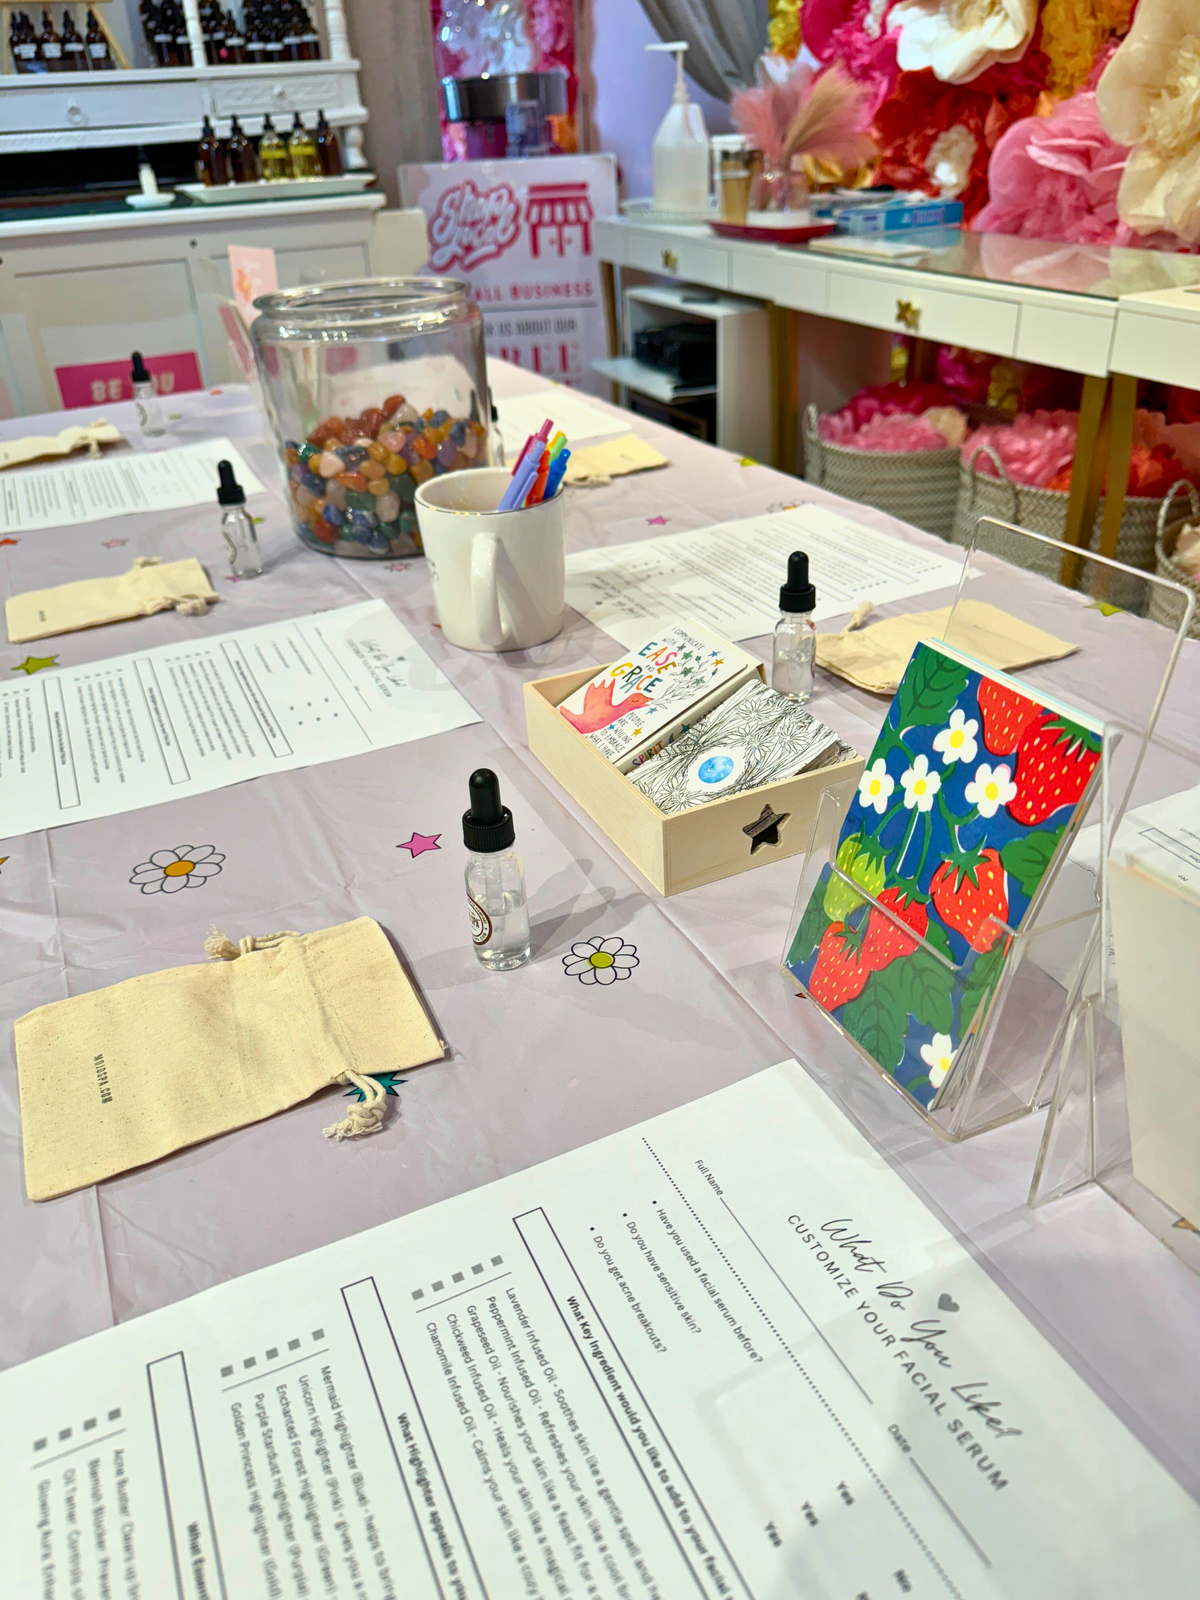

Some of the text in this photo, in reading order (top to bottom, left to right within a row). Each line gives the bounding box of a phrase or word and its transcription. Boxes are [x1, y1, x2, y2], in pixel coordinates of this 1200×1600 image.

[508, 281, 593, 301] BUSINESS
[487, 342, 583, 374] REE
[91, 378, 123, 403] BE
[637, 641, 678, 675] EASE
[661, 636, 678, 647] WITH
[673, 628, 705, 651] COMMUNICATE
[610, 662, 664, 694] GRACE
[613, 726, 633, 745] WILLING
[617, 717, 629, 728] ARE
[624, 711, 646, 728] PEOPLE
[589, 732, 602, 746] WHAT
[600, 746, 616, 760] HAVE
[599, 727, 627, 754] TO EMBRACE
[631, 740, 664, 767] SPIRIT
[694, 1159, 724, 1196] Full Name
[592, 1235, 668, 1353] Do you get acne breakouts?
[626, 1221, 702, 1334] Do you have sensitive skin?
[656, 1208, 764, 1363] Have you used a facial serum before?
[820, 1218, 887, 1274] What
[875, 1280, 914, 1311] Do
[899, 1319, 952, 1369] You
[787, 1214, 1010, 1492] CUSTOMIZE YOUR FACIAL SERUM
[446, 1313, 475, 1365] Chickweed
[466, 1363, 491, 1404] Infused
[483, 1402, 499, 1421] Oil
[492, 1425, 512, 1459] Heals
[502, 1457, 524, 1485] your
[466, 1304, 496, 1355] Grapeseed
[487, 1354, 503, 1371] Oil
[497, 1376, 526, 1430] Nourishes
[517, 1428, 538, 1455] your
[531, 1455, 548, 1481] skin
[485, 1295, 517, 1351] Peppermint
[510, 1349, 536, 1389] Infused
[527, 1388, 543, 1406] Oil
[537, 1410, 569, 1467] Refreshes
[559, 1465, 582, 1493] your
[505, 1287, 532, 1330] Lavender
[525, 1329, 551, 1367] Infused
[543, 1366, 558, 1384] Oil
[553, 1388, 580, 1433] Soothes
[573, 1432, 591, 1456] skin
[585, 1454, 601, 1477] like
[566, 1295, 585, 1322] What
[579, 1320, 595, 1340] Key
[588, 1339, 623, 1393] Ingredient
[616, 1391, 642, 1426] would
[631, 1424, 651, 1448] you
[645, 1445, 663, 1470] like
[657, 1468, 670, 1485] to
[230, 1401, 247, 1441] Golden
[253, 1392, 270, 1429] Purple
[298, 1374, 317, 1416] Unicorn
[309, 1414, 334, 1476] Highlighter
[320, 1365, 343, 1411] Mermaid
[333, 1410, 359, 1470] Highlighter
[426, 1322, 453, 1376] Chamomile
[446, 1375, 471, 1416] Infused
[462, 1415, 478, 1434] Oil
[471, 1438, 492, 1476] Calms
[482, 1474, 504, 1503] your
[275, 1383, 300, 1441] Enchanted
[289, 1439, 308, 1478] Forest
[261, 1427, 282, 1478] Stardust
[397, 1411, 415, 1444] What
[407, 1442, 437, 1508] Highlighter
[835, 1480, 855, 1506] Yes
[800, 1500, 820, 1527] Yes
[764, 1520, 783, 1548] Yes
